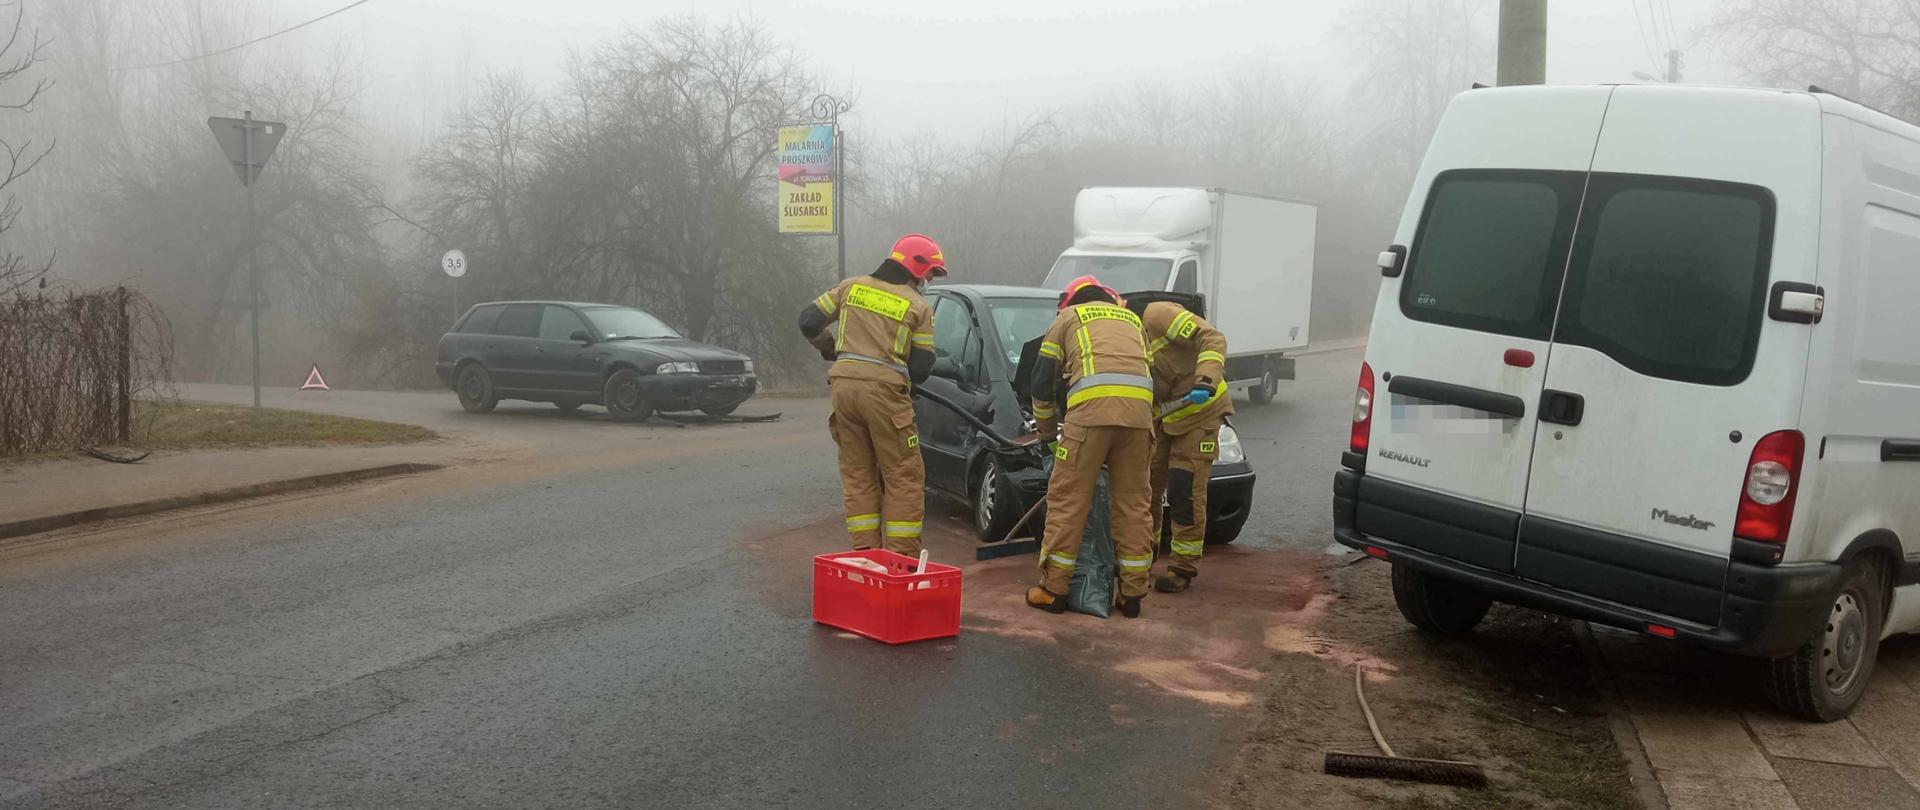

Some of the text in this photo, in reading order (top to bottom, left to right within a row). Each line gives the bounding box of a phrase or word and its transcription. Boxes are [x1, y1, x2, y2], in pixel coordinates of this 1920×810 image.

[785, 140, 825, 151] MALARNIA
[782, 153, 829, 165] PROSZKOWA
[790, 192, 822, 203] ZAKŁAD
[784, 203, 828, 217] ŚLUSARSKI
[1202, 443, 1214, 451] PSP
[1379, 448, 1431, 468] RENAULT
[1651, 507, 1716, 531] Master
